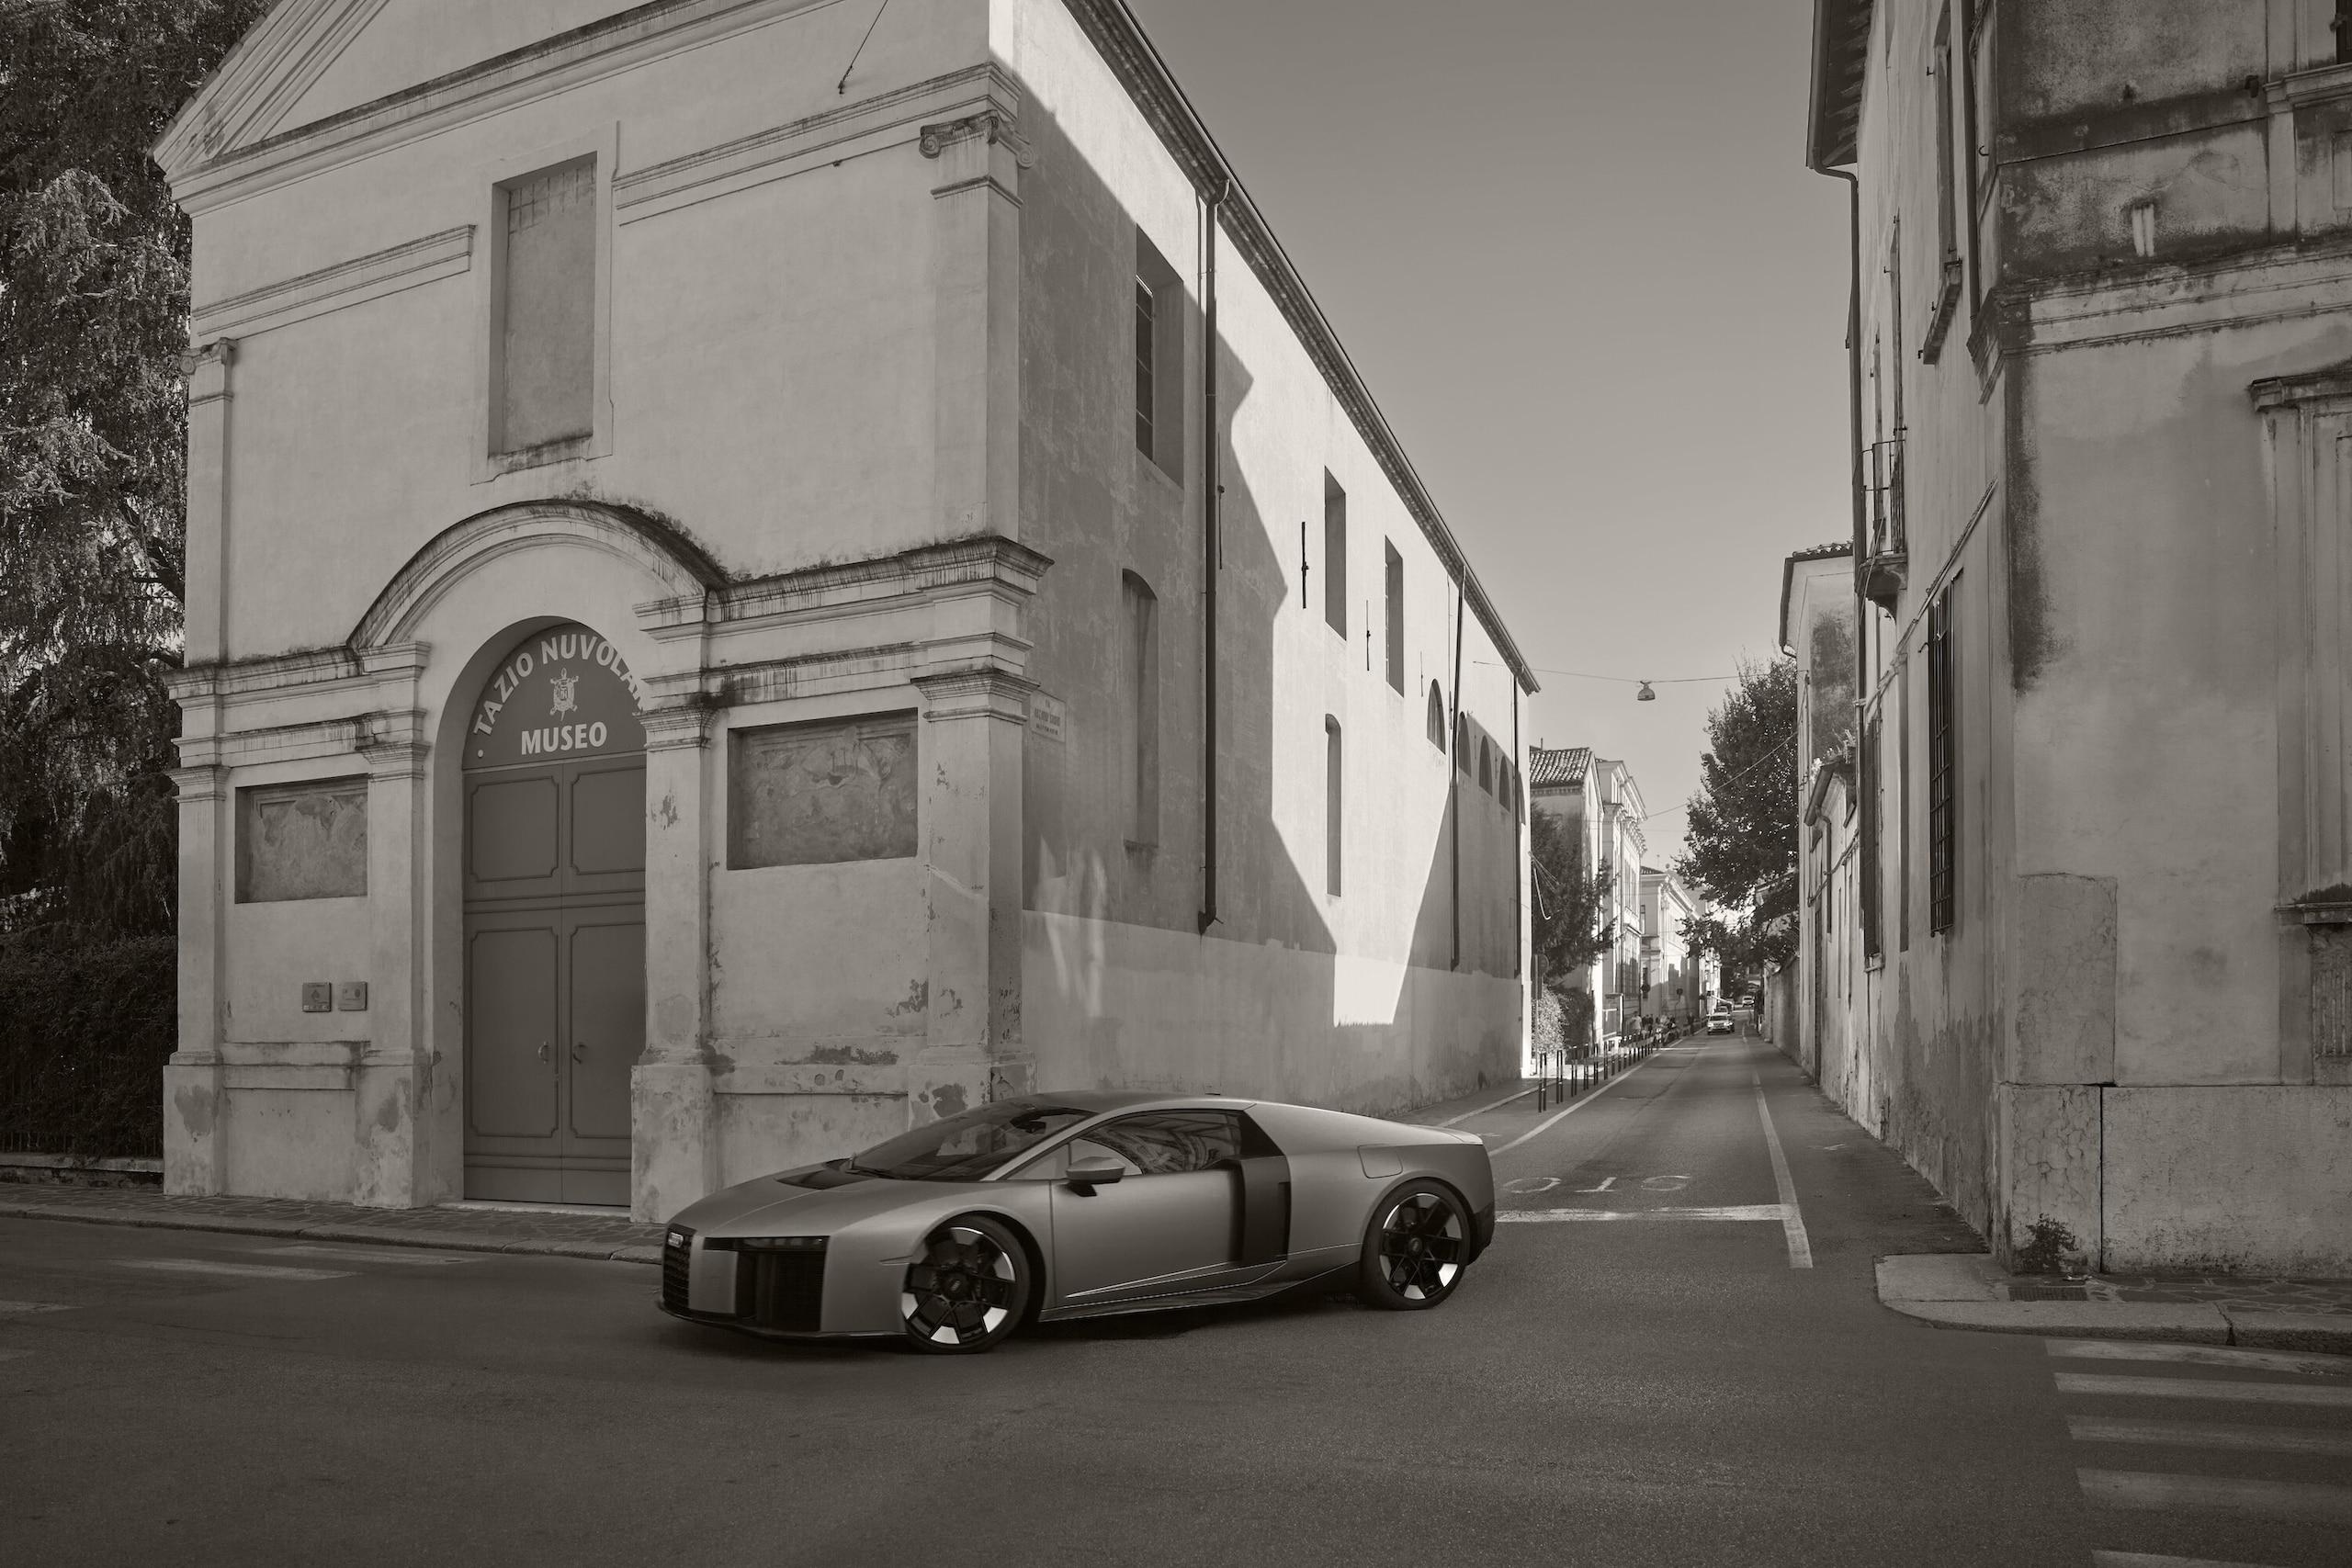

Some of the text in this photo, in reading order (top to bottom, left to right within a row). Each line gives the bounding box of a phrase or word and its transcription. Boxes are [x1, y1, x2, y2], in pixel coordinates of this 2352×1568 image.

[473, 634, 643, 736] TAZIO NUVOLA
[521, 721, 607, 755] MUSEO
[1500, 1175, 1692, 1193] STO
